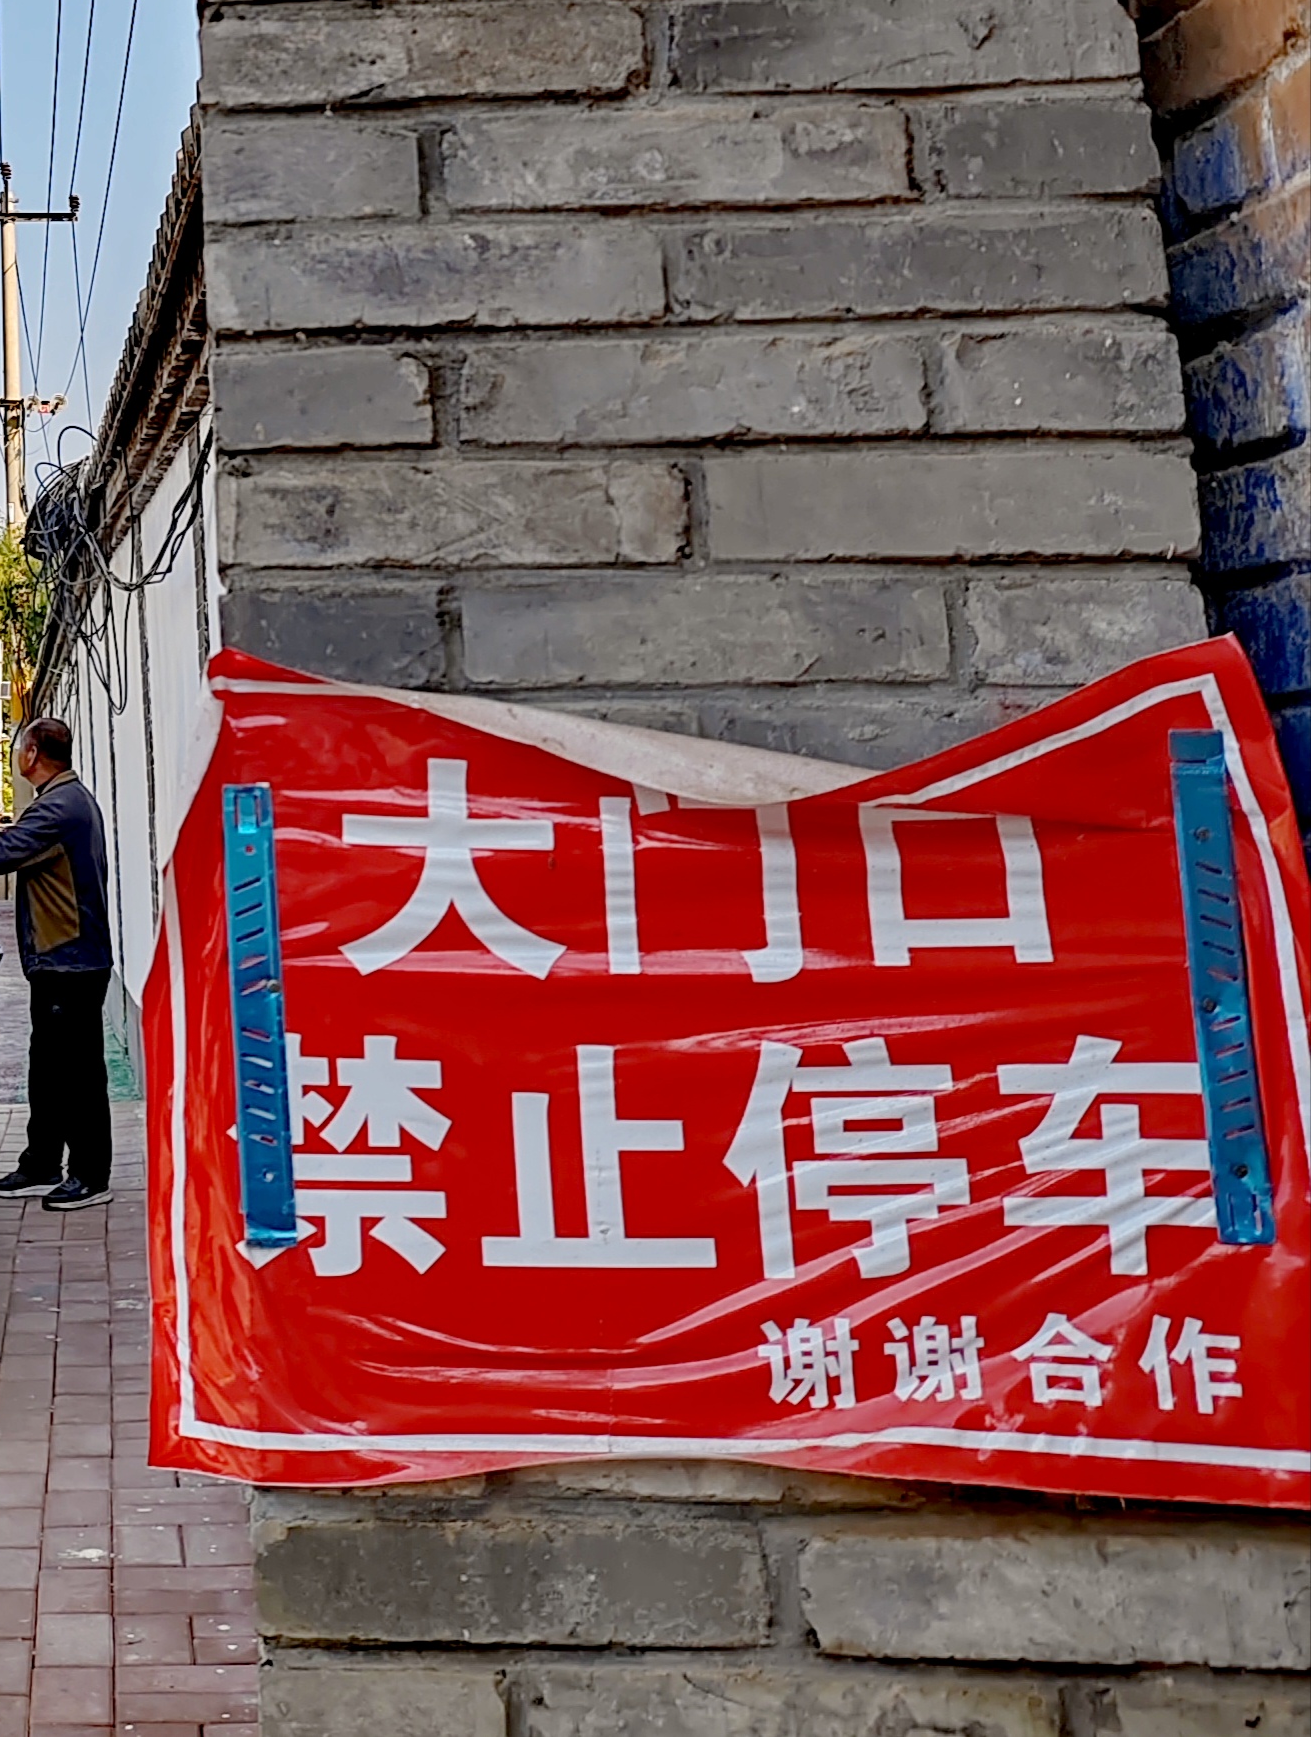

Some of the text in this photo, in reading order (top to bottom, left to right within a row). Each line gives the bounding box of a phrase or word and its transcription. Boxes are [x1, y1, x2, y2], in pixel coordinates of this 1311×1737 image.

[340, 758, 1055, 981] 大门口
[228, 1035, 1219, 1279] 禁止停车
[757, 1311, 1244, 1415] 谢谢合作
